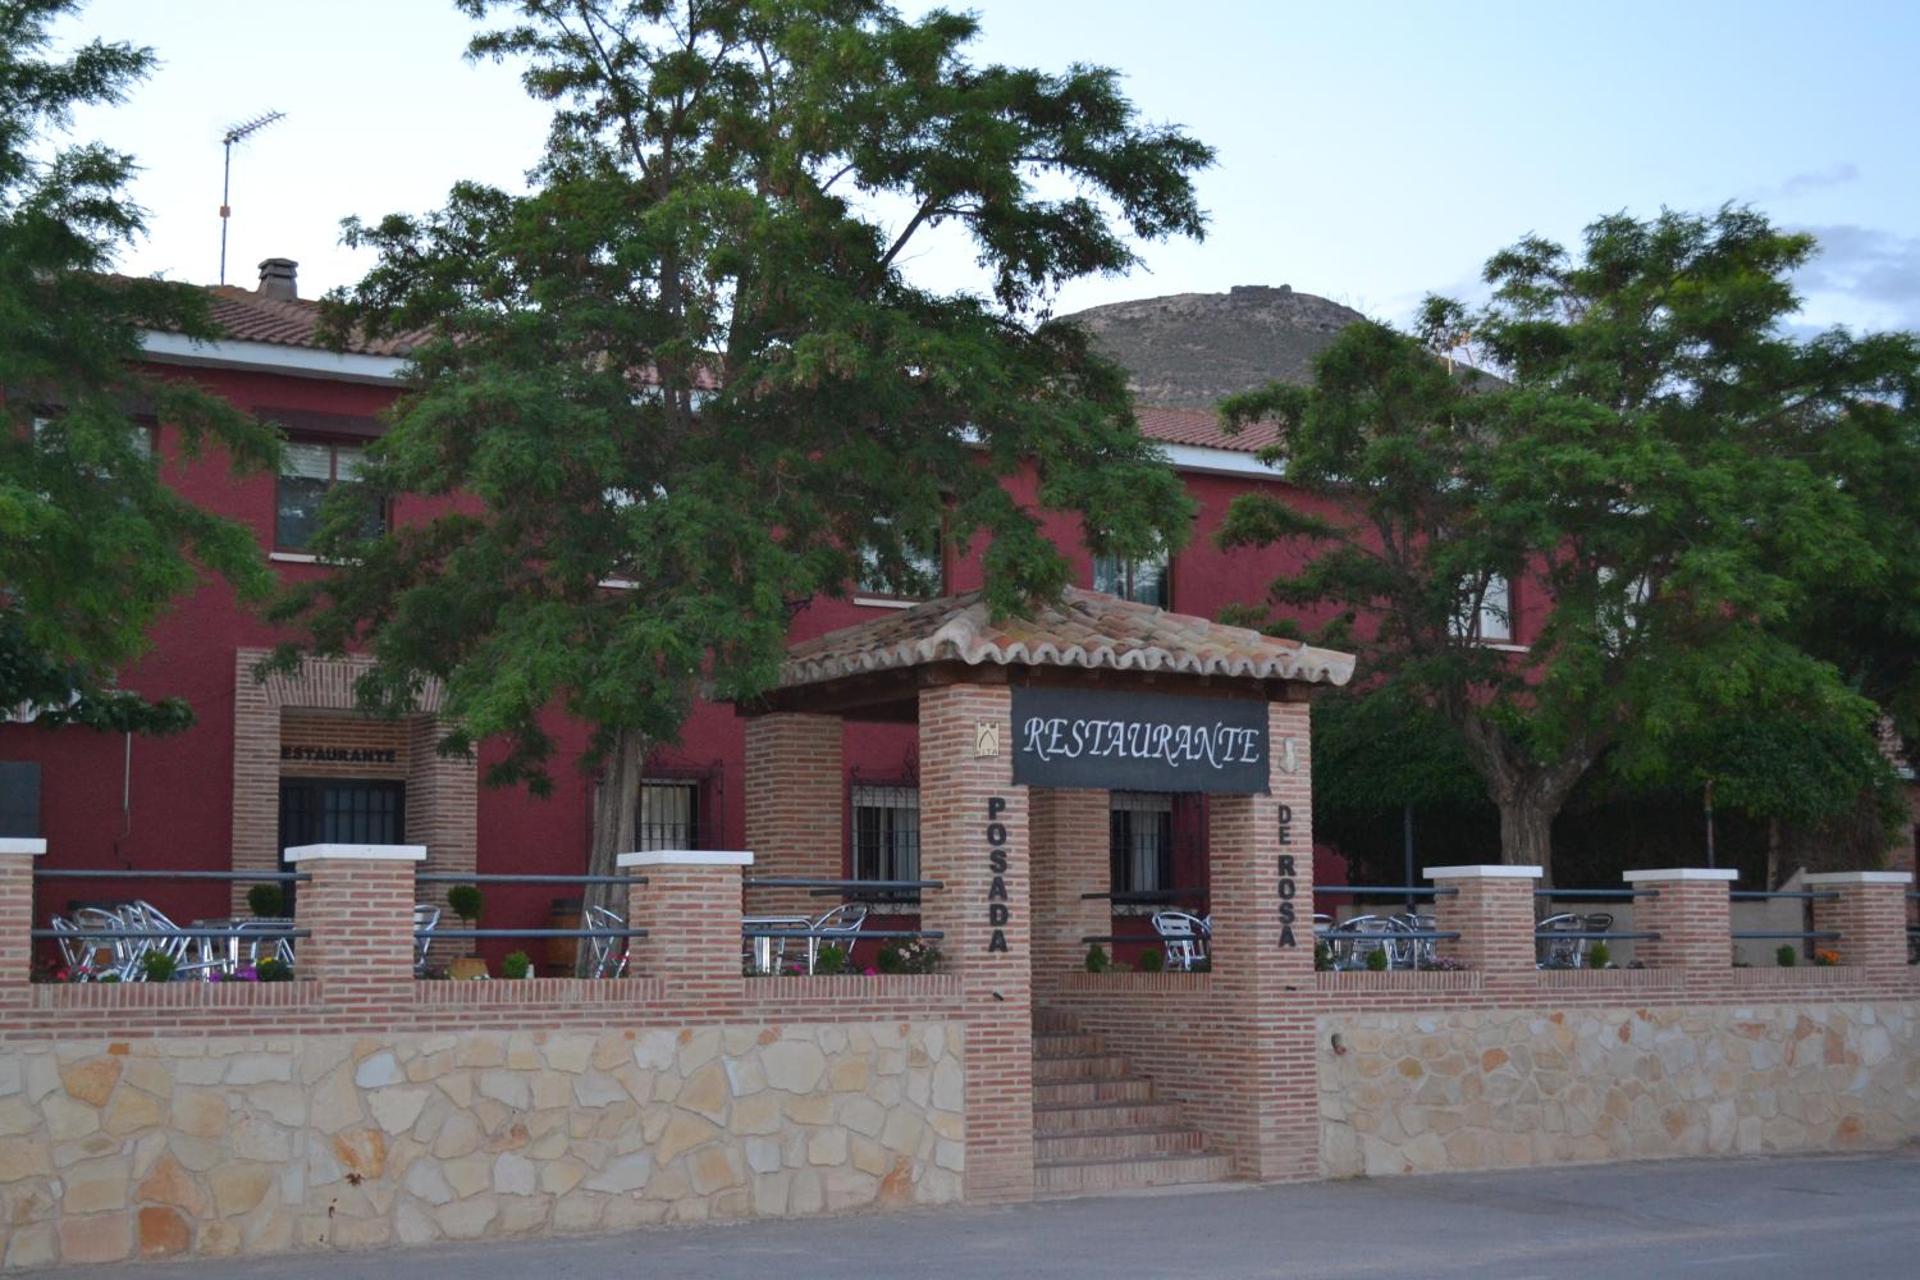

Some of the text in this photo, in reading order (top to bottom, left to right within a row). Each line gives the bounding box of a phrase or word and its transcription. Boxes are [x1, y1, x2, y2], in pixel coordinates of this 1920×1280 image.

[281, 745, 396, 762] ESTAURANTE
[1023, 717, 1260, 769] RESTAURANTE
[987, 797, 1008, 952] POSADA
[1278, 805, 1296, 948] DE ROSA
